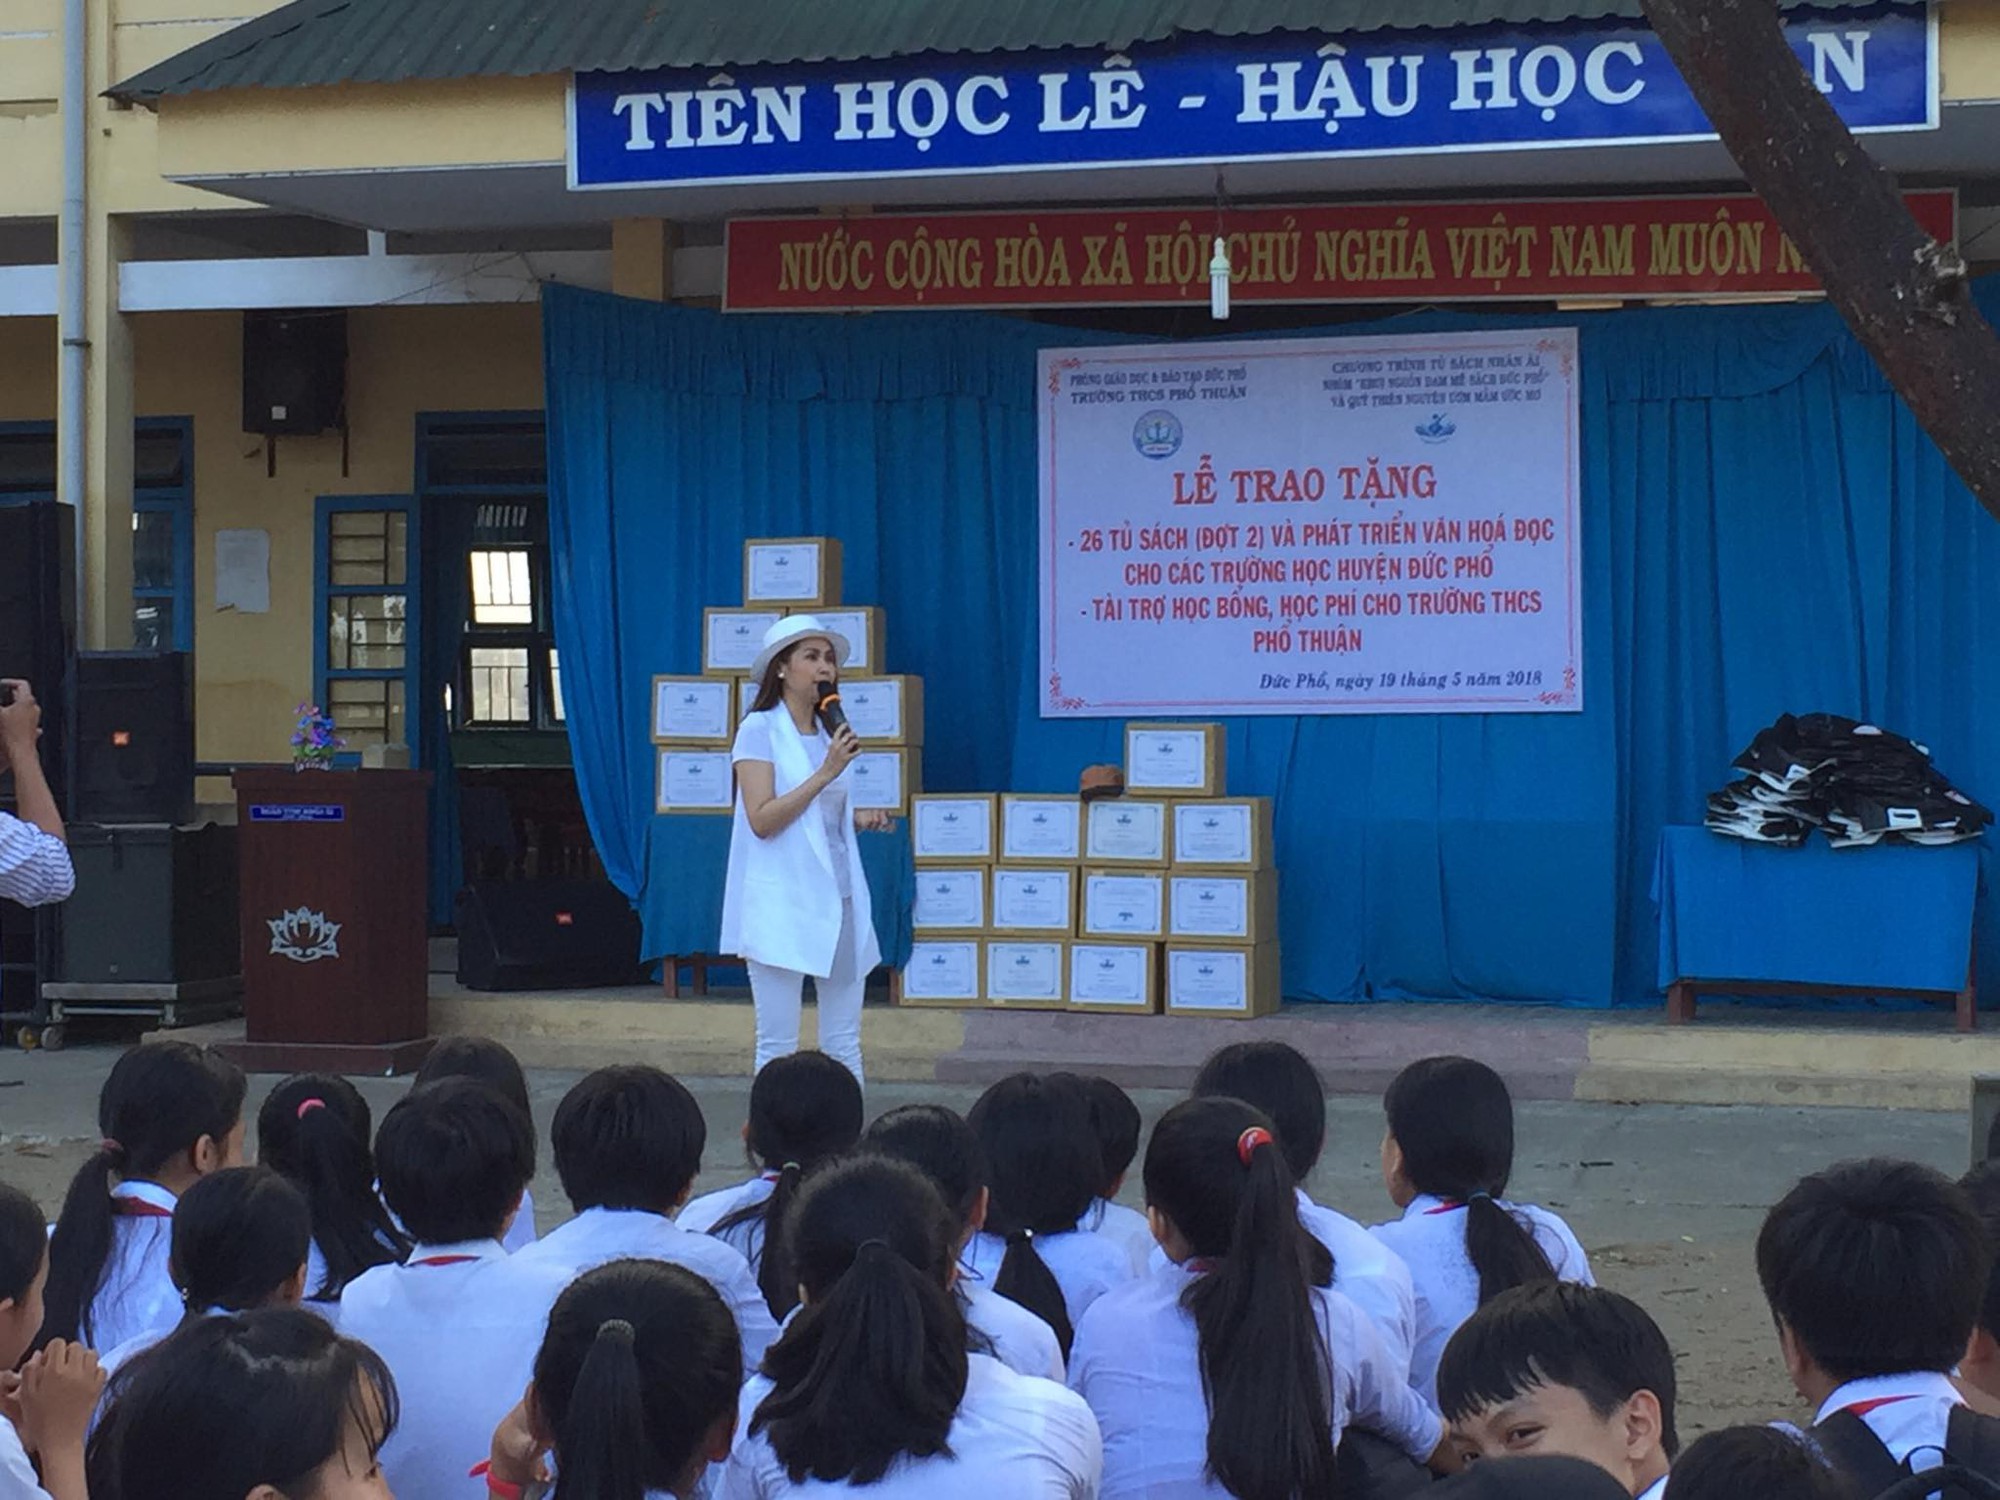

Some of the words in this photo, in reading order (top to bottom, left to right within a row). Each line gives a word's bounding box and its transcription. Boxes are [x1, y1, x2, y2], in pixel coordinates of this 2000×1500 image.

[613, 72, 806, 151] TIÊN
[833, 76, 1011, 152] HỌC
[1236, 44, 1424, 135] HẬU
[1449, 41, 1646, 122] HỌC
[778, 226, 874, 292] NƯỚC
[885, 226, 984, 300] CỘNG
[994, 222, 1070, 287] HÒA
[1080, 222, 1133, 285] XÃ
[1145, 219, 1212, 297] HỘI
[1226, 216, 1300, 284] CHỦ
[1314, 218, 1435, 283] NGHĨA
[1445, 213, 1537, 292] VIỆT
[1549, 224, 1636, 279] NAM
[1648, 206, 1765, 278] MUÔN
[1129, 388, 1166, 402] THCS
[1173, 454, 1218, 505] LỄ
[1230, 468, 1325, 504] TRAO
[1337, 456, 1437, 508] TẶNG
[1080, 530, 1103, 551] 26
[1109, 519, 1132, 550] TỦ
[1139, 522, 1188, 550] SÁCH
[1196, 524, 1239, 553] (ĐỢT
[1246, 525, 1264, 549] 2)
[1271, 519, 1296, 548] VÀ
[1303, 518, 1352, 547] PHÁT
[1358, 510, 1416, 545] TRIỂN
[1422, 517, 1461, 543] VĂN
[1468, 513, 1507, 542] HOÁ
[1514, 518, 1555, 547] ĐỌC
[1124, 563, 1161, 585] CHO
[1168, 557, 1205, 585] CÁC
[1210, 554, 1286, 584] TRƯỜNG
[1292, 559, 1331, 586] HỌC
[1338, 552, 1401, 585] HUYỆN
[1407, 551, 1448, 580] ĐỨC
[1454, 545, 1493, 578] PHỔ
[1092, 593, 1122, 620] TÀI
[1128, 595, 1167, 625] TRỢ
[1172, 597, 1210, 624] HỌC
[1216, 585, 1274, 622] BỔNG,
[1280, 595, 1319, 621] HỌC
[1325, 588, 1357, 616] PHÍ
[1362, 594, 1401, 616] CHO
[1407, 587, 1485, 615] TRƯỜNG
[1491, 590, 1542, 613] THCS
[1253, 619, 1292, 652] PHỔ
[1297, 624, 1362, 656] THUẬN
[1259, 673, 1291, 690] Đức
[1335, 675, 1373, 690] ngày
[1378, 673, 1396, 688] 19
[1400, 671, 1447, 690] tháng
[1452, 672, 1461, 687] 5
[1466, 672, 1501, 687] năm
[1506, 670, 1542, 686] 2018
